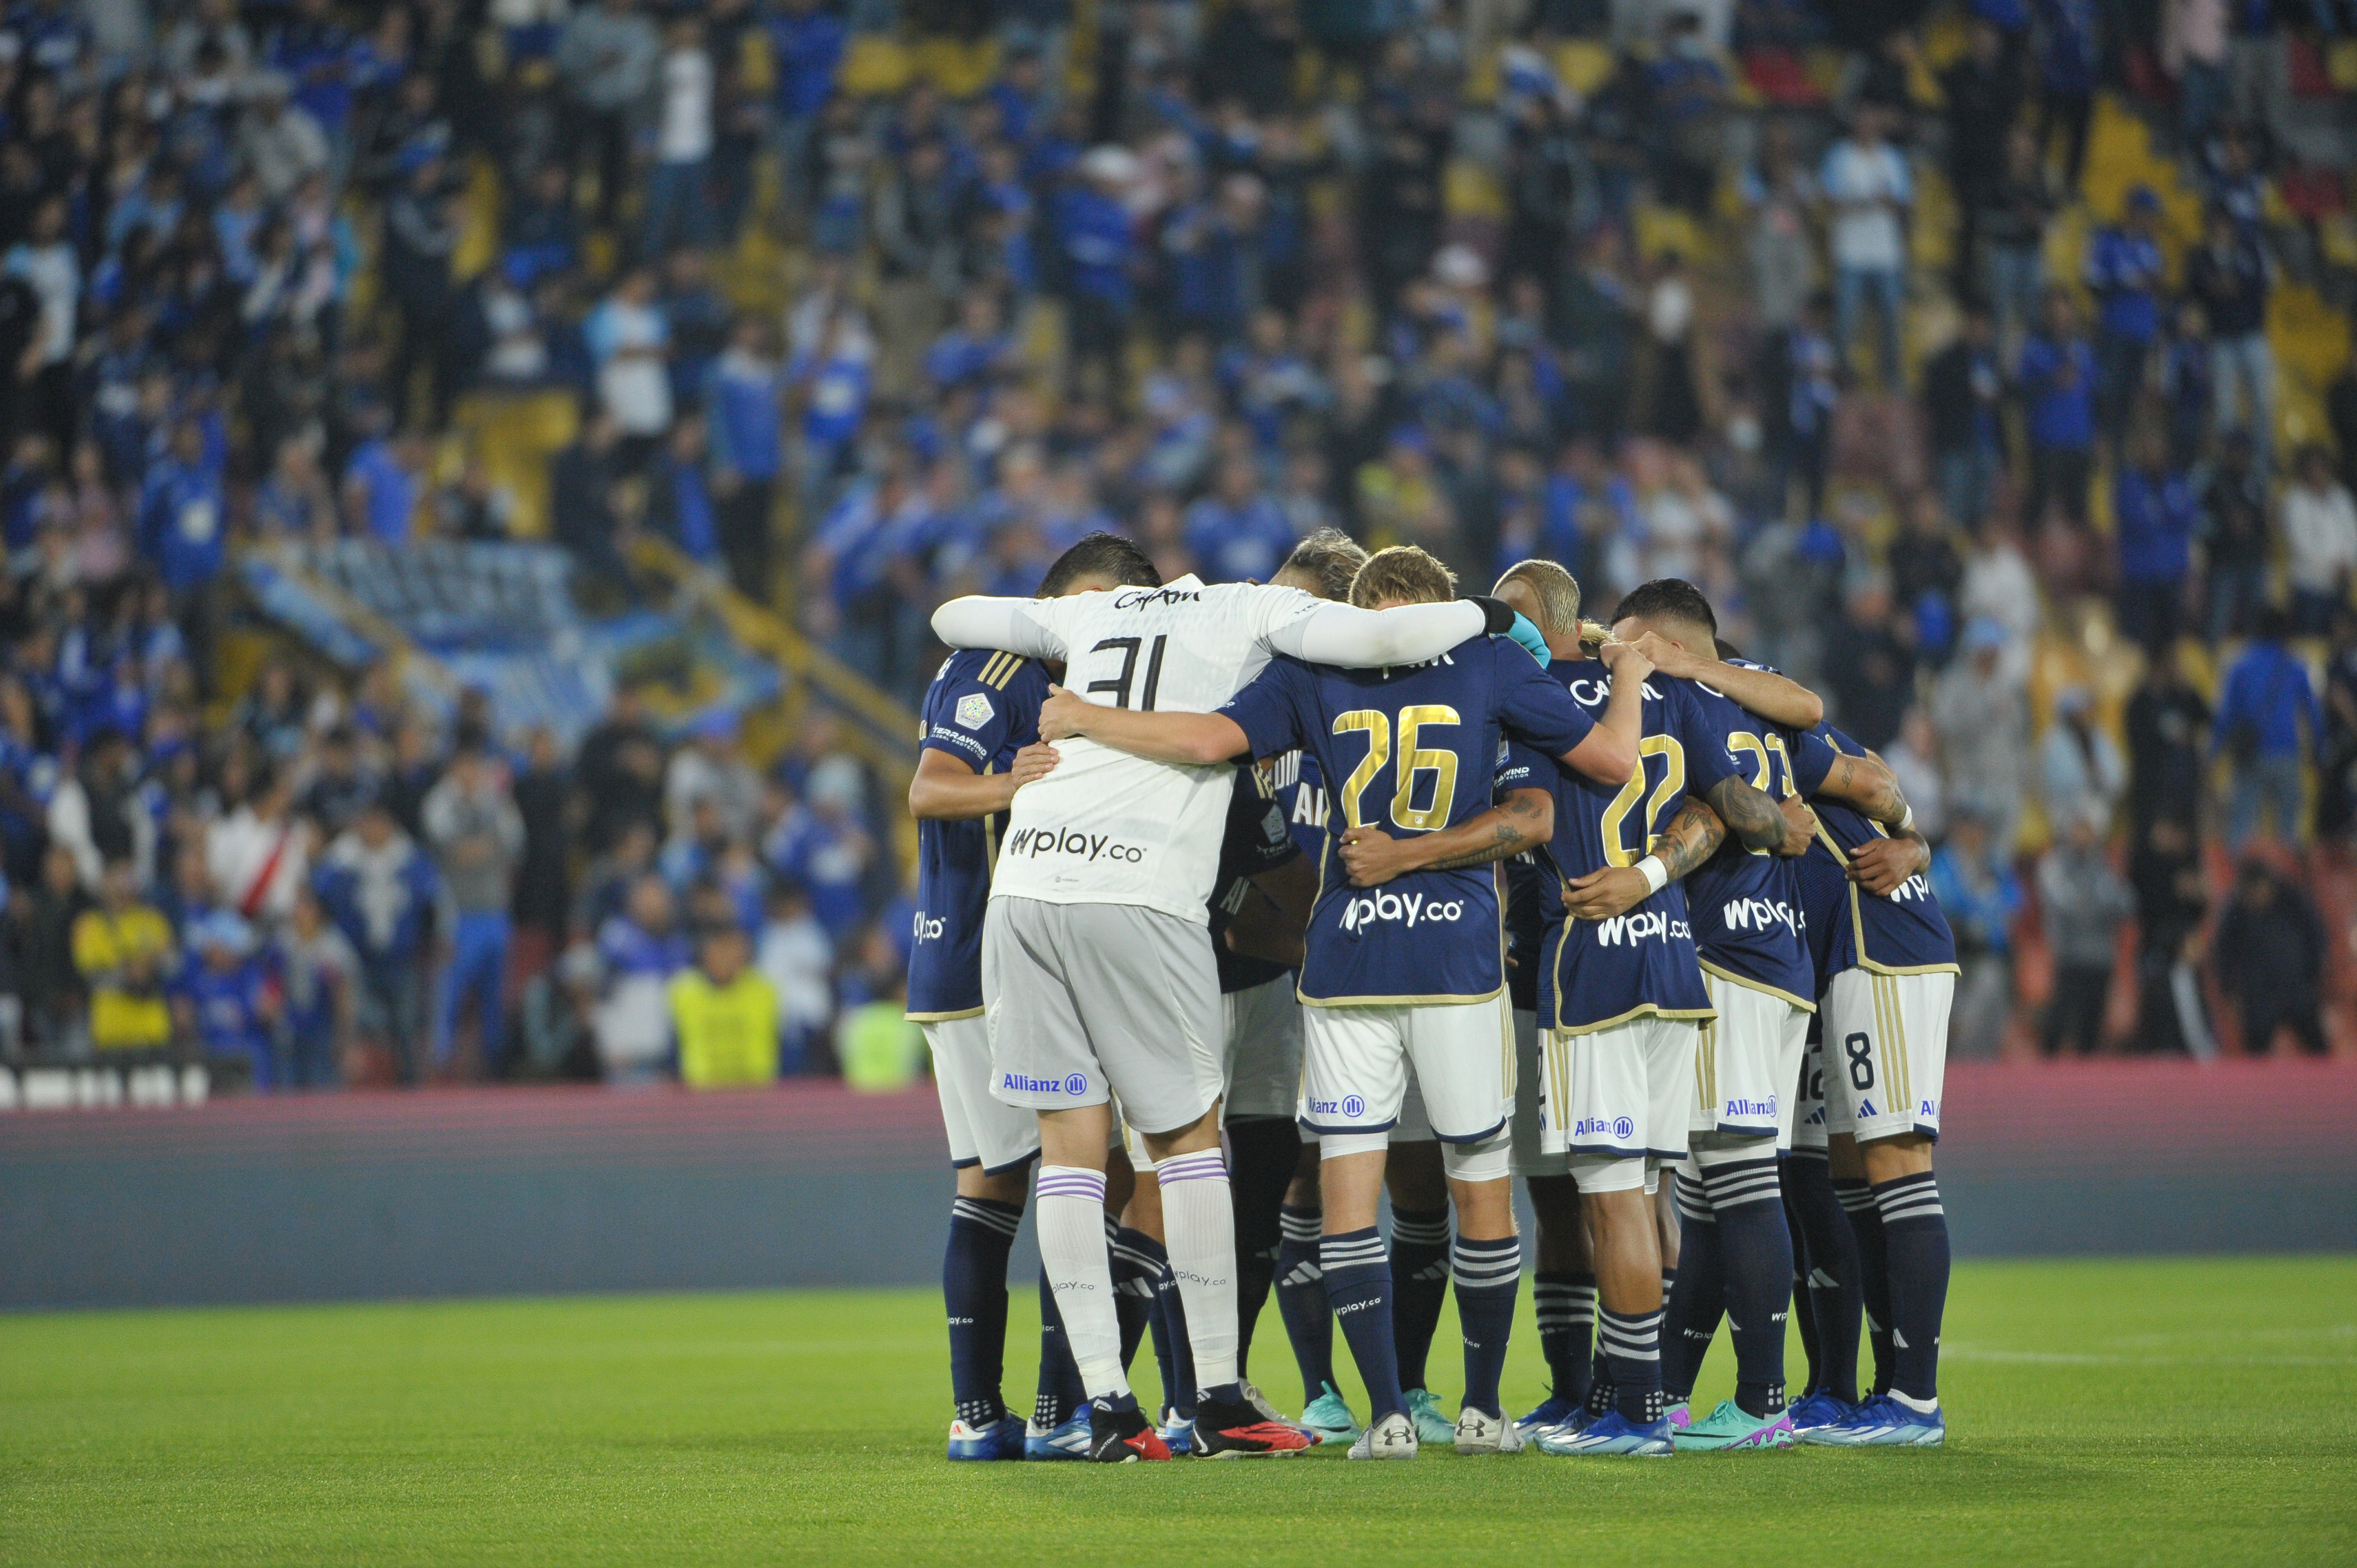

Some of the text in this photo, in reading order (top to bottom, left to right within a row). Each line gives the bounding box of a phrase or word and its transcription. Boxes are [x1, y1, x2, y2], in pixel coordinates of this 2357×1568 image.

[1087, 634, 1167, 712] 31
[933, 722, 987, 757] TERRAWIND
[1332, 704, 1461, 832] 26
[1003, 1073, 1061, 1092] Allianz
[1845, 1031, 1875, 1091] 8
